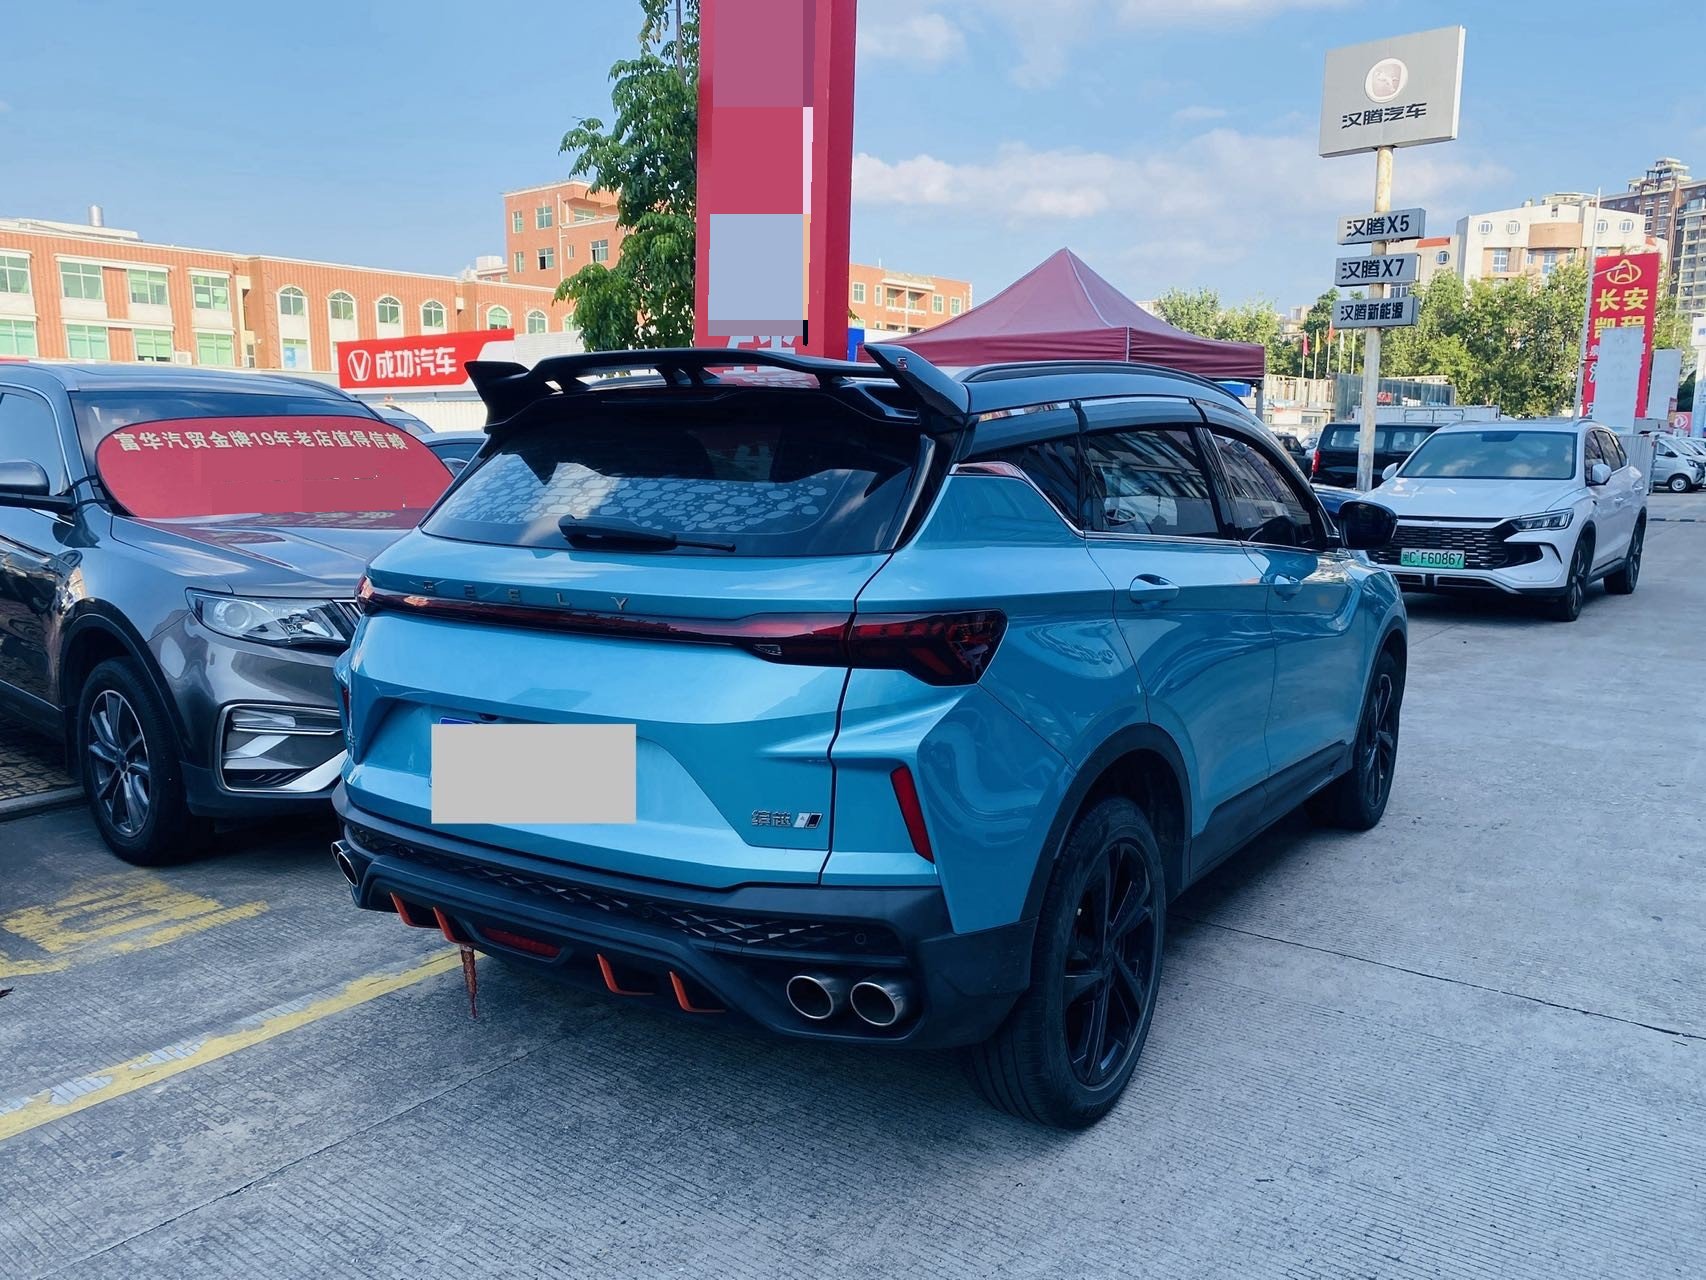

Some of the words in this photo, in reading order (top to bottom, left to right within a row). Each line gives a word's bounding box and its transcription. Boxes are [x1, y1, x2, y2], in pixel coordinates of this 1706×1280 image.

[1341, 102, 1427, 129] 汉腾汽车
[1346, 214, 1410, 237] 汉腾X5
[1341, 258, 1405, 280] 汉腾X7
[1596, 287, 1649, 312] 长安
[1340, 302, 1404, 321] 汉腾新能源
[375, 347, 457, 379] 成功汽车
[113, 430, 409, 452] 富华汽贸金牌19年老店值得信赖
